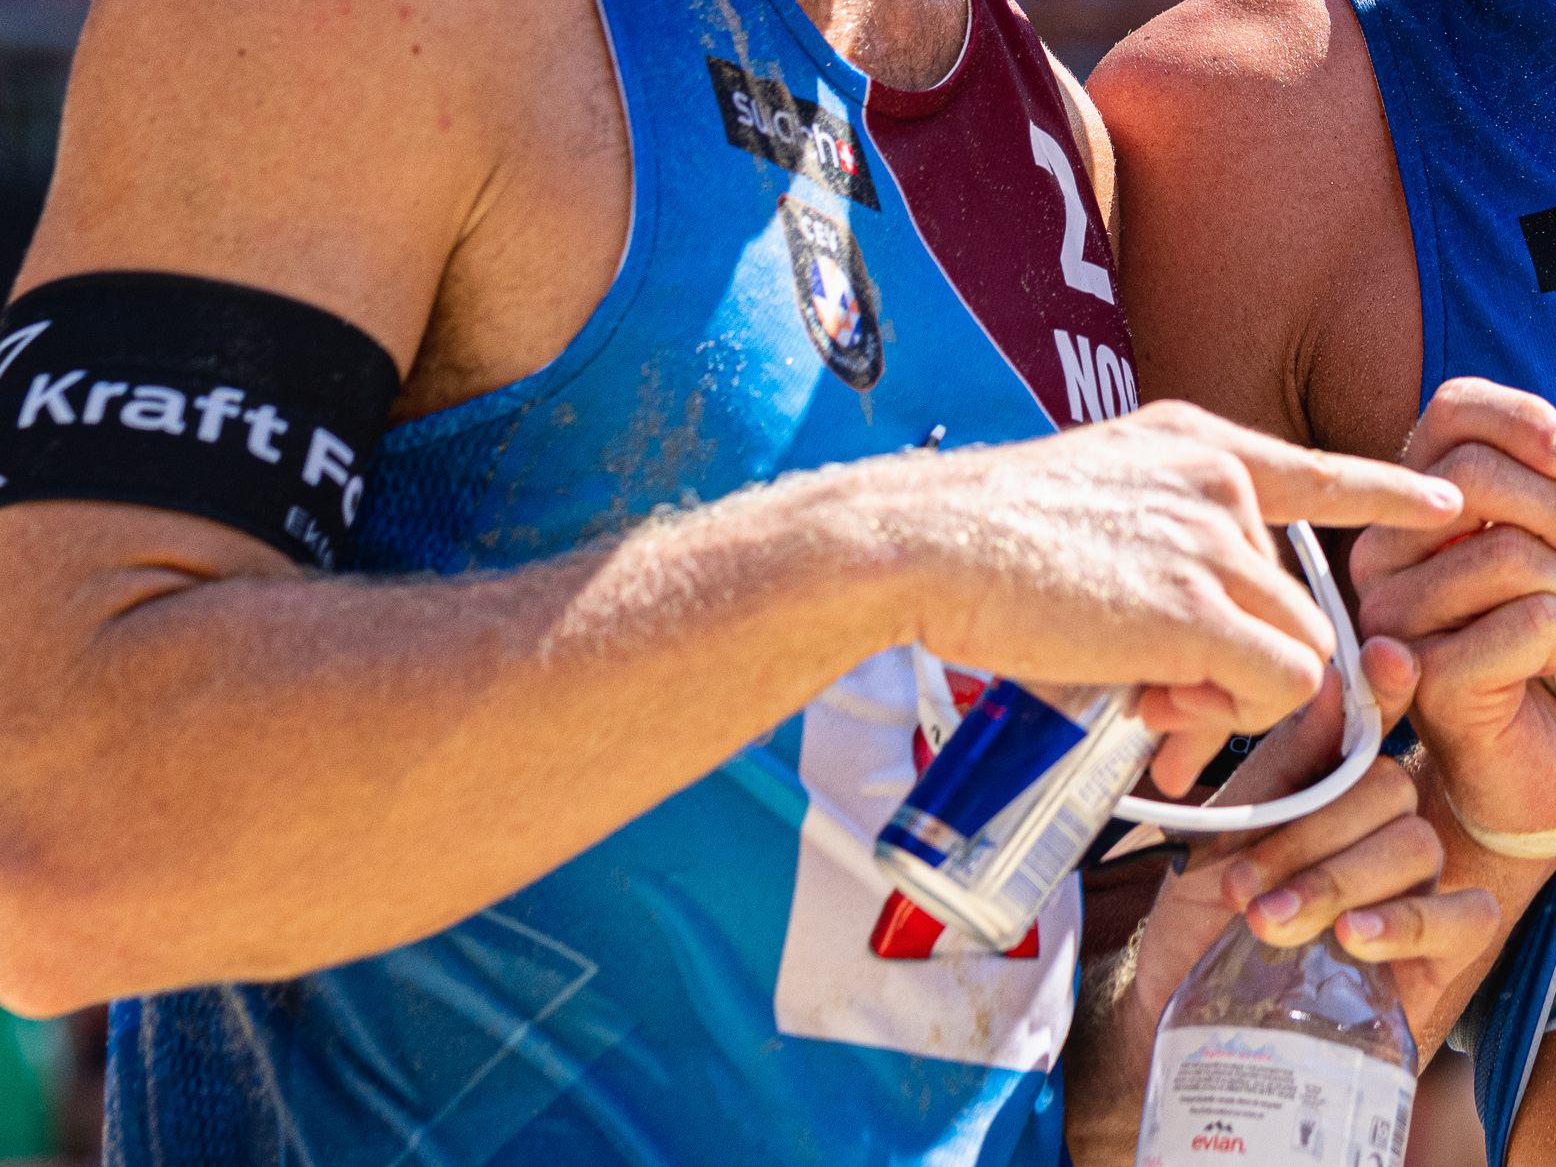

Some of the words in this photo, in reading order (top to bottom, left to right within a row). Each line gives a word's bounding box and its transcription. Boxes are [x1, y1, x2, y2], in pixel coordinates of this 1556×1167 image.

[1029, 119, 1115, 306] 2
[16, 368, 290, 465] Kraft
[1191, 1133, 1246, 1155] evian
